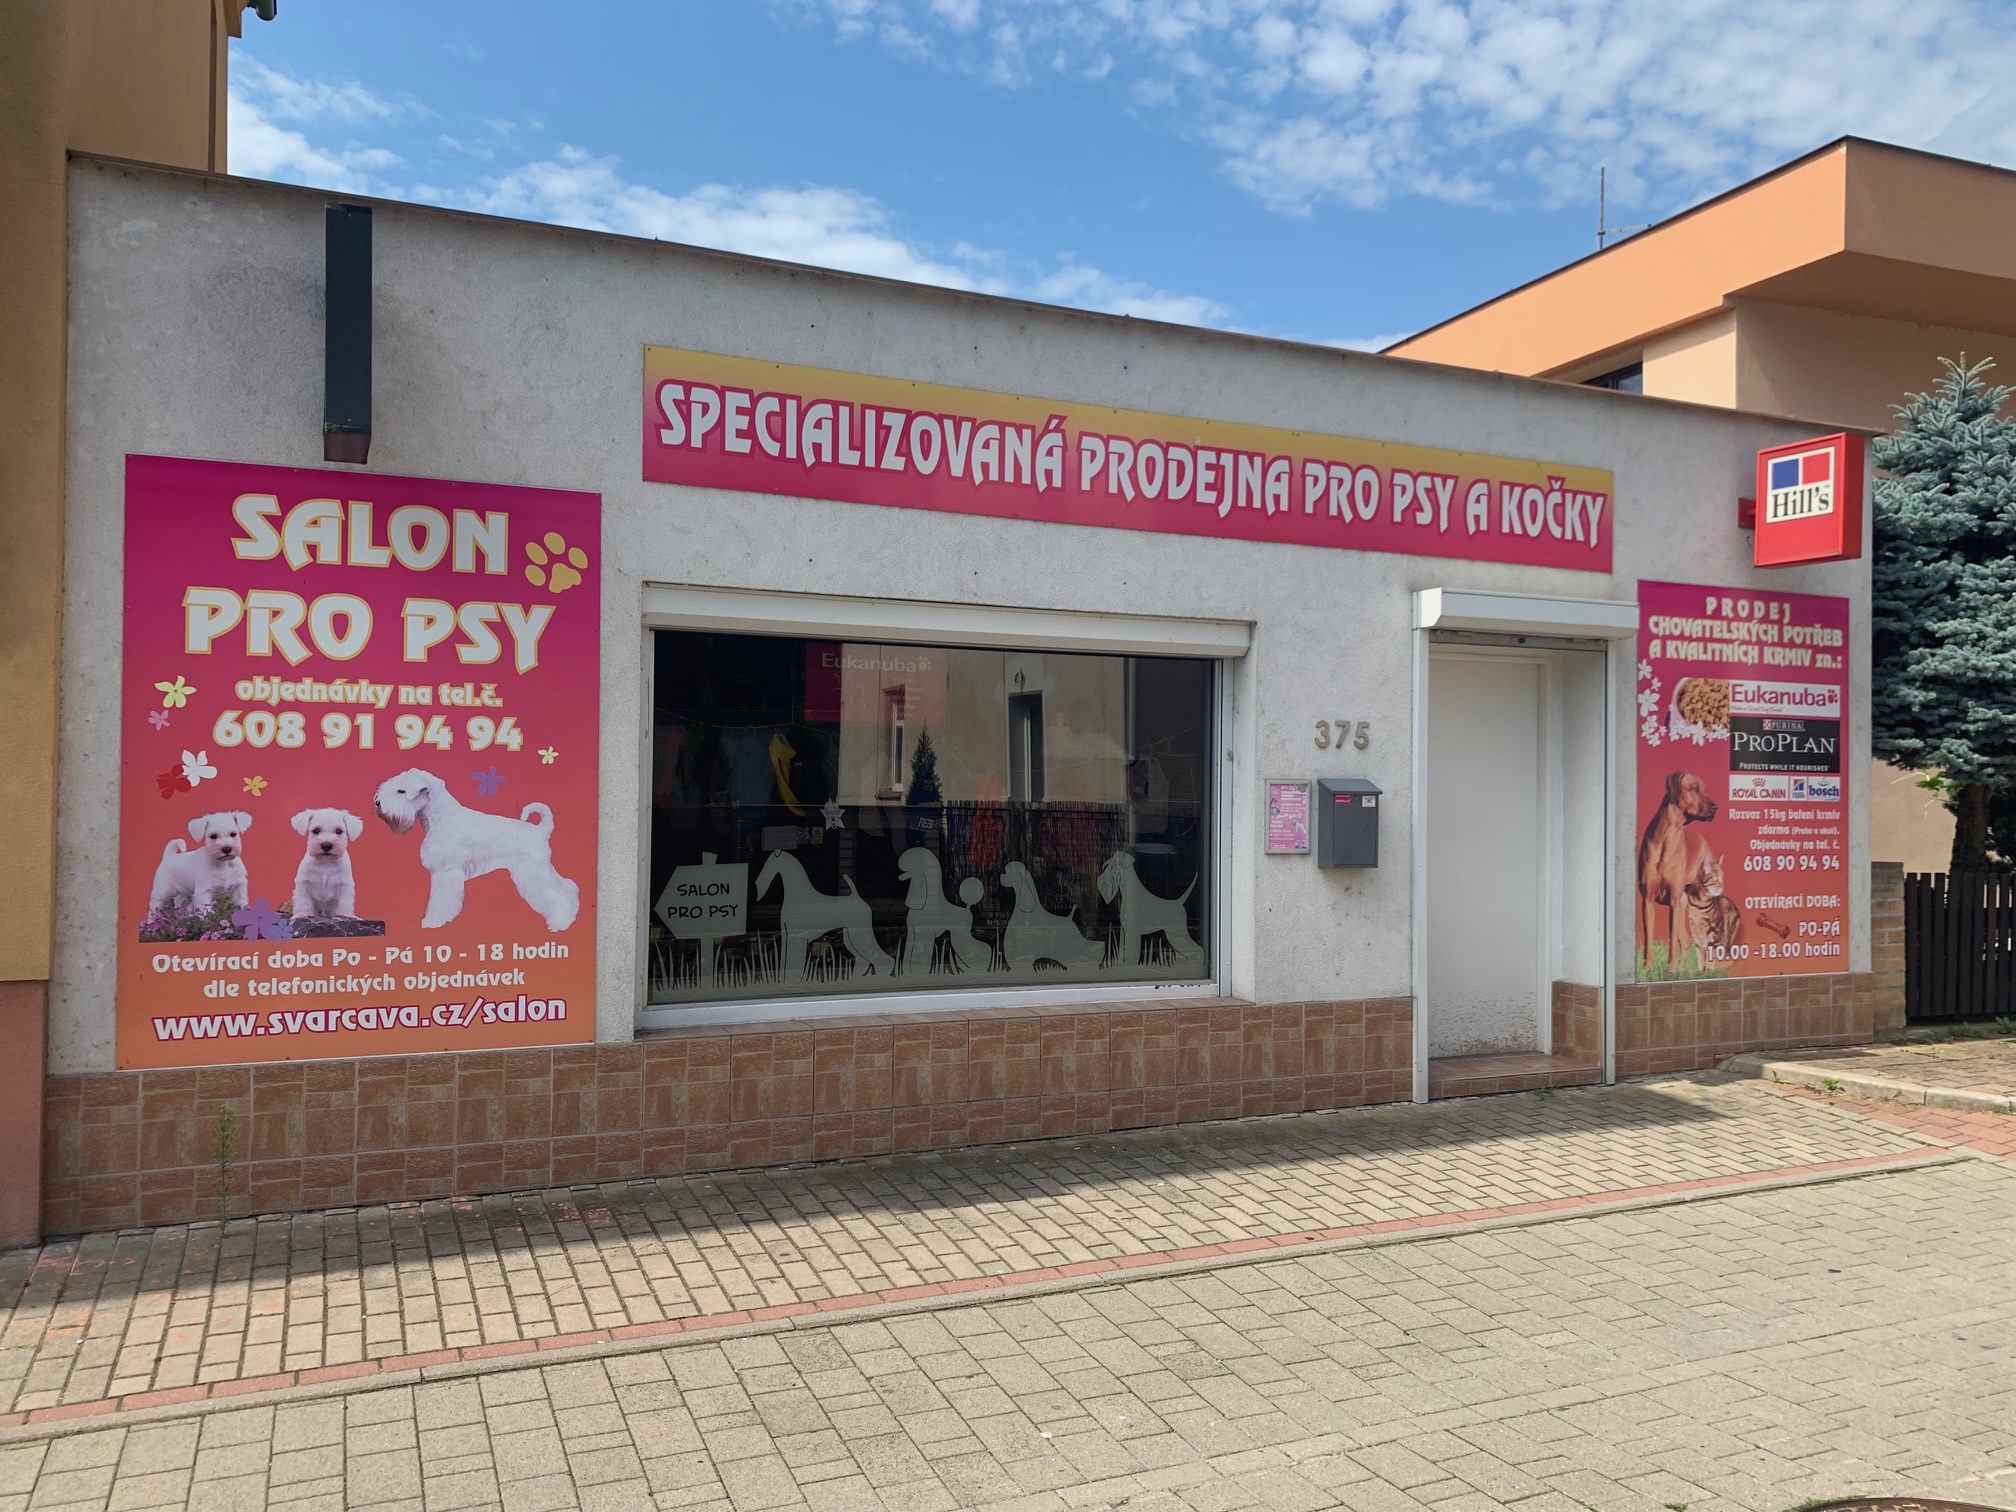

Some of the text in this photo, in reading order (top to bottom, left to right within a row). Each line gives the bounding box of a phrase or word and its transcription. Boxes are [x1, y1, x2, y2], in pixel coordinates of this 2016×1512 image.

[659, 382, 1605, 548] SPECIALIZOVANÁ PRODEJNA PRO PSY A KOČKY
[1771, 487, 1830, 518] Hill's
[231, 493, 509, 575] SALON
[182, 586, 556, 675] PRO PSY
[1648, 615, 1843, 647] CHOVATELSKÝCH POTŘEB
[821, 652, 917, 673] Eukanuba
[1649, 639, 1661, 659] A
[1665, 640, 1759, 665] KVALITNÍCH
[1763, 646, 1812, 667] KRMIV
[235, 675, 503, 709] objednávky na tel.č.
[1731, 683, 1826, 707] Eukanuba
[213, 710, 523, 751] 608 91 94 94
[1314, 719, 1370, 750] 375
[1771, 721, 1802, 730] PURINA
[1732, 788, 1786, 799] ROYAL CANIN
[1809, 785, 1840, 797] bosch
[1729, 808, 1761, 820] Rozvoz
[1763, 808, 1786, 821] 15kg
[1816, 809, 1840, 820] krmiv
[1758, 824, 1789, 835] zdarma
[1750, 839, 1840, 852] Objednávky na tel. č.
[1743, 855, 1840, 871] 608 90 94 94
[677, 883, 730, 896] SALON
[1745, 893, 1841, 909] OTEVÍRACÍ DOBA:
[668, 904, 739, 919] PRO PSY
[152, 951, 260, 974] Otevírací
[268, 950, 323, 969] doba
[332, 948, 361, 967] Po
[385, 946, 414, 966] Pá
[424, 944, 452, 964] 10
[477, 943, 504, 962] 18
[511, 942, 569, 962] hodin
[1706, 944, 1750, 961] 10.00
[1805, 941, 1840, 957] hodin
[203, 968, 525, 999] dle telefonických objednávek
[151, 994, 567, 1042] www.svarcava.cz/salon
